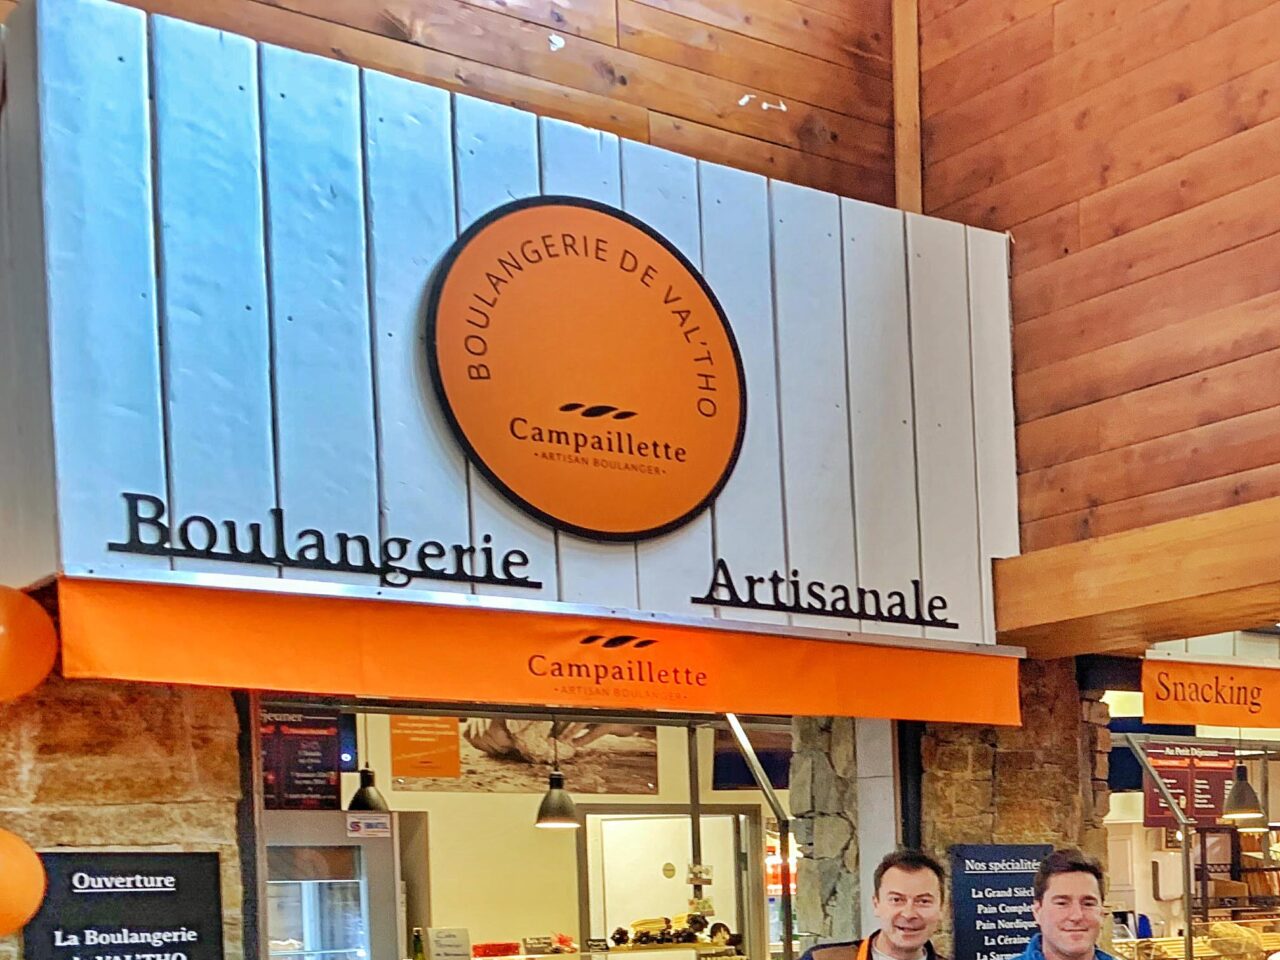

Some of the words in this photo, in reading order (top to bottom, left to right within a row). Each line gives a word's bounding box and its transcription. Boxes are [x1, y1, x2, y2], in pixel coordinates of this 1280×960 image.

[464, 234, 608, 381] BOULANGERIE
[619, 248, 659, 288] DE
[662, 286, 718, 418] VAL'THO
[509, 417, 687, 463] Campaillette
[541, 451, 589, 466] ARTISAN
[593, 457, 661, 475] BOULANGER
[119, 491, 532, 588] Boulangerie
[702, 557, 950, 625] Artisanale
[528, 654, 708, 687] Campaillette
[1155, 671, 1263, 714] Snacking
[965, 859, 986, 871] Nos
[72, 871, 176, 890] Ouverture
[971, 888, 983, 899] La
[984, 887, 1012, 898] Grand
[1013, 886, 1035, 898] Siècl
[977, 903, 998, 915] Pain
[54, 930, 80, 947] La
[84, 926, 198, 947] Boulangerie
[976, 920, 996, 931] Pain
[984, 935, 996, 946] La
